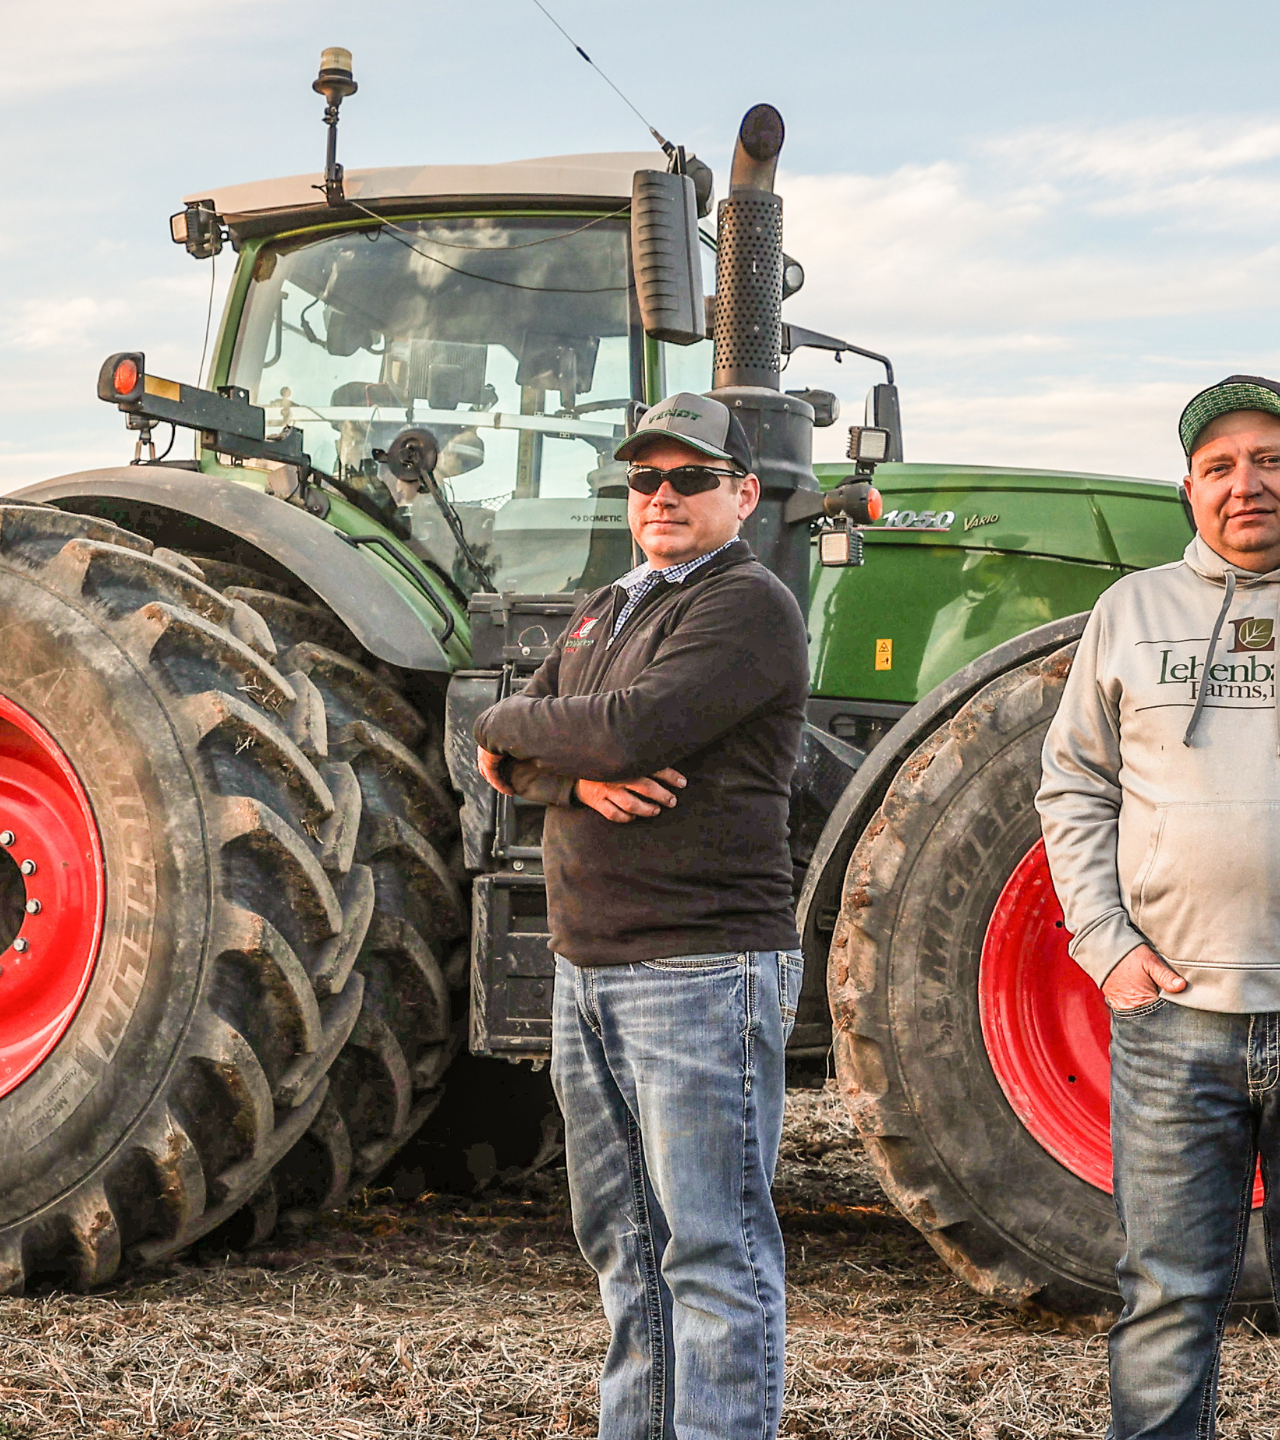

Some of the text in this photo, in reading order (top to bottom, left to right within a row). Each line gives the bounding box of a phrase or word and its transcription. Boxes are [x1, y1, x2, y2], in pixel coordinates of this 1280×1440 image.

[582, 514, 623, 523] DOMETIC
[882, 509, 1000, 532] 1050 VARIO
[920, 772, 1039, 984] MICHELI
